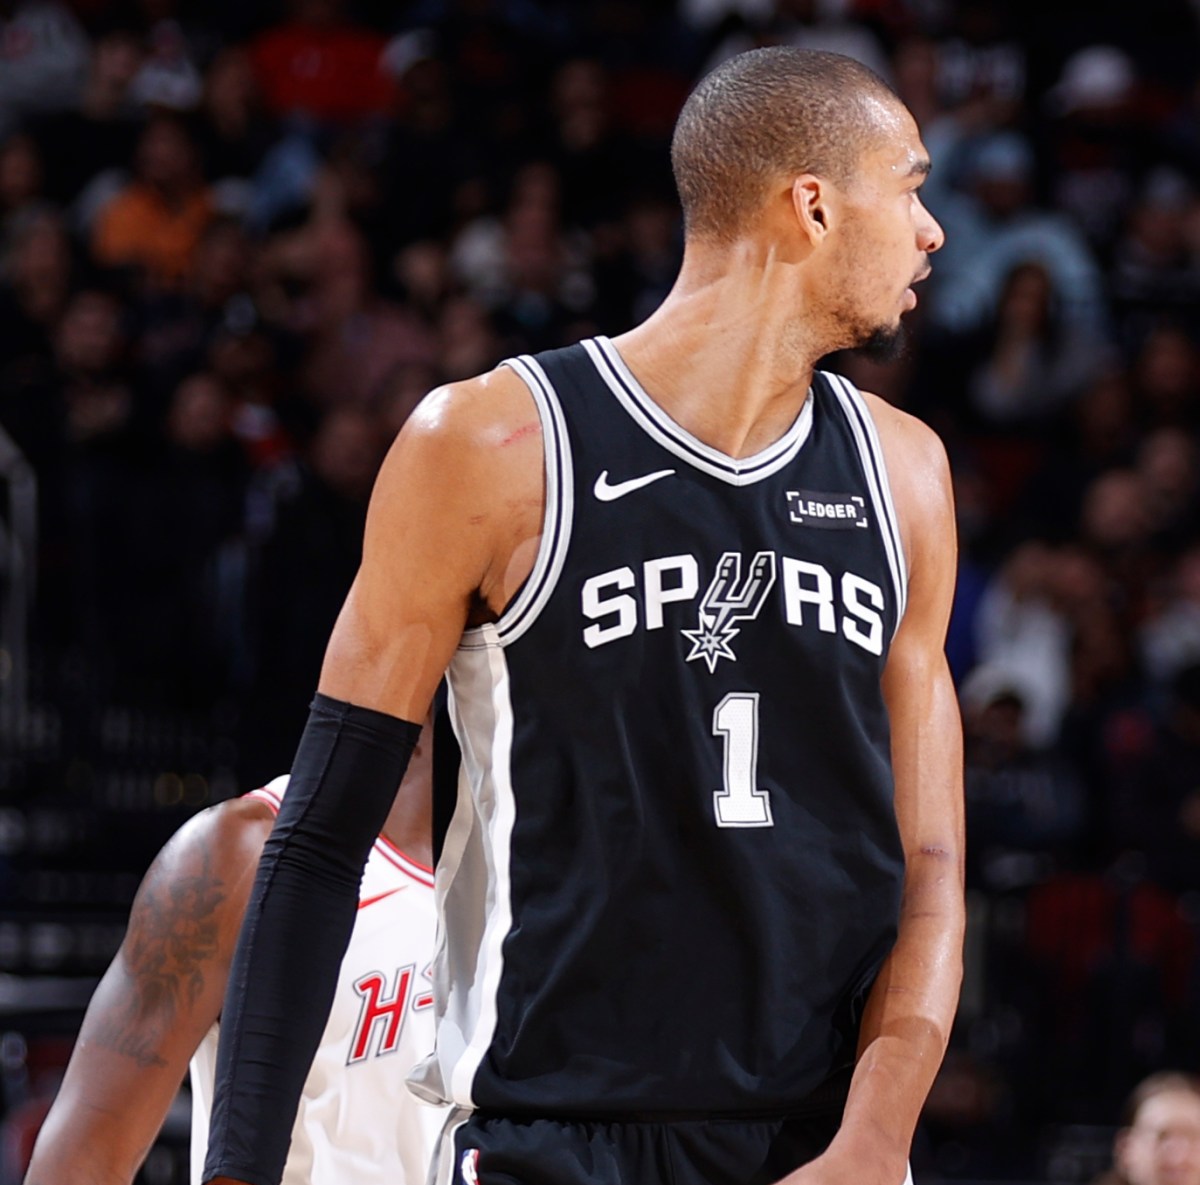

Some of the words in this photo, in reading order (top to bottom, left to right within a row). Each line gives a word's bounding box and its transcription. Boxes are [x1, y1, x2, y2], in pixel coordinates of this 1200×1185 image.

[797, 499, 857, 518] LEDGER
[581, 551, 885, 674] SPURS
[712, 692, 774, 828] 1
[345, 962, 435, 1067] H-
